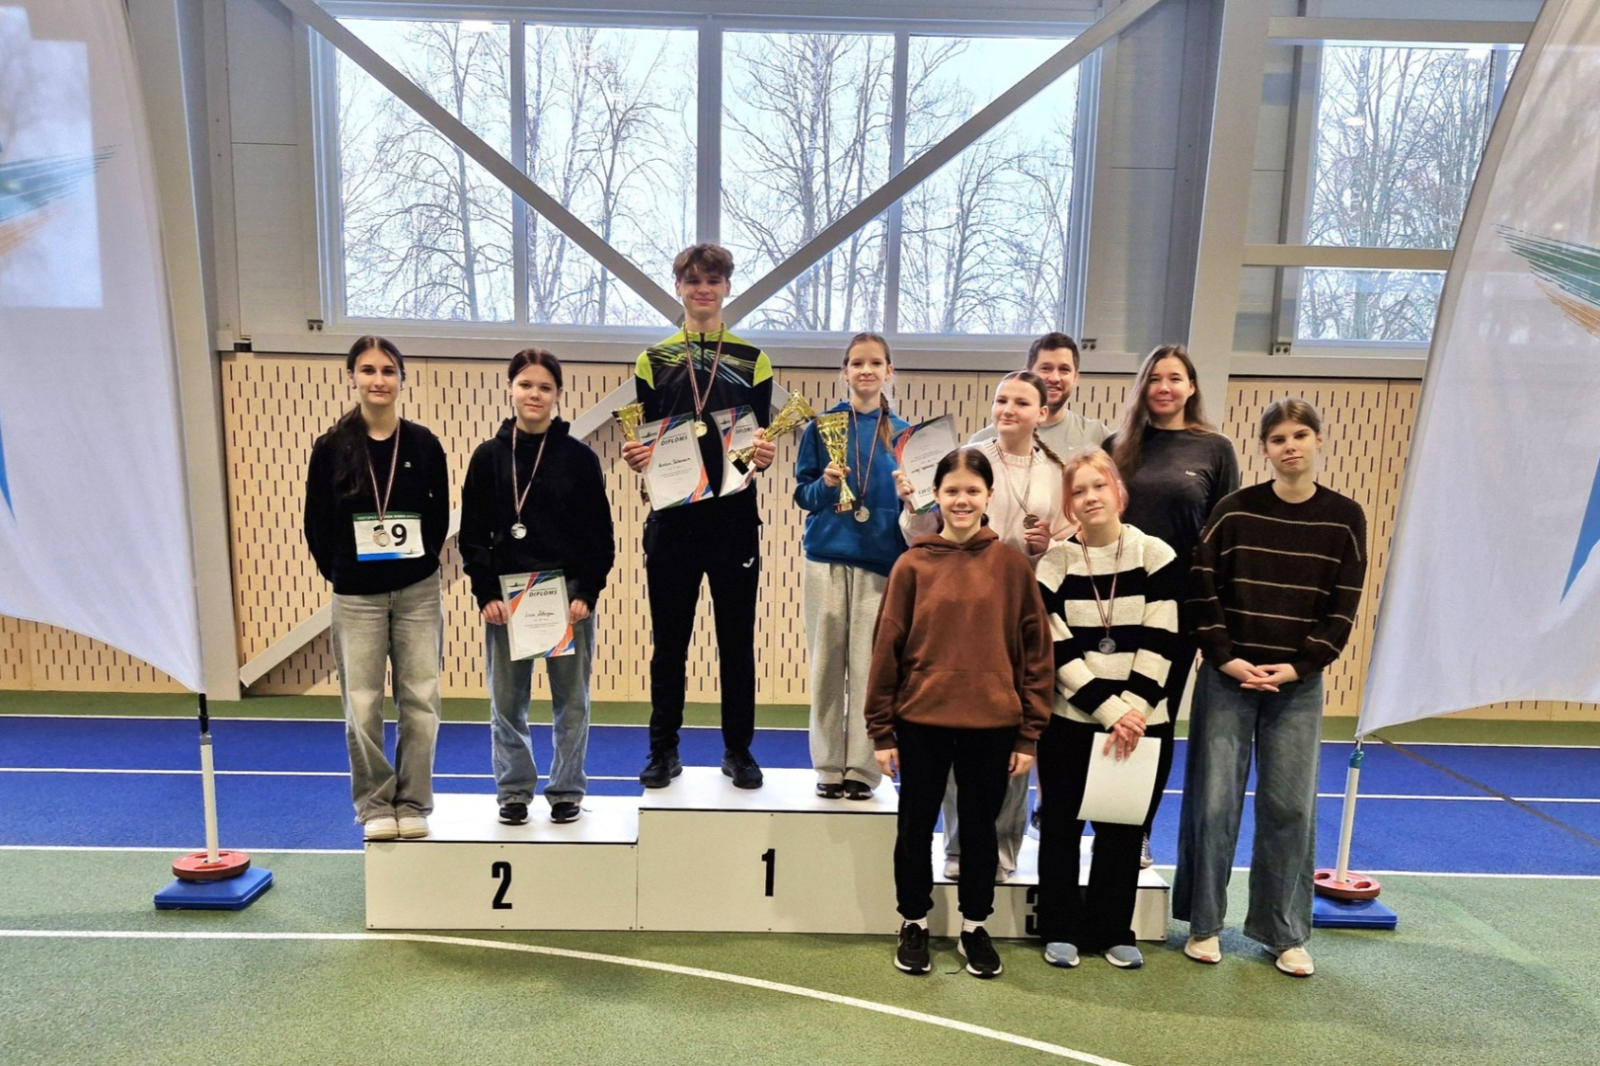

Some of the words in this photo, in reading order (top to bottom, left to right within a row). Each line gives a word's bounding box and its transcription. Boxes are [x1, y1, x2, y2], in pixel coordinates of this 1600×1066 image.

[660, 435, 688, 446] DIPLOMS
[491, 861, 512, 910] 2
[761, 848, 776, 897] 1
